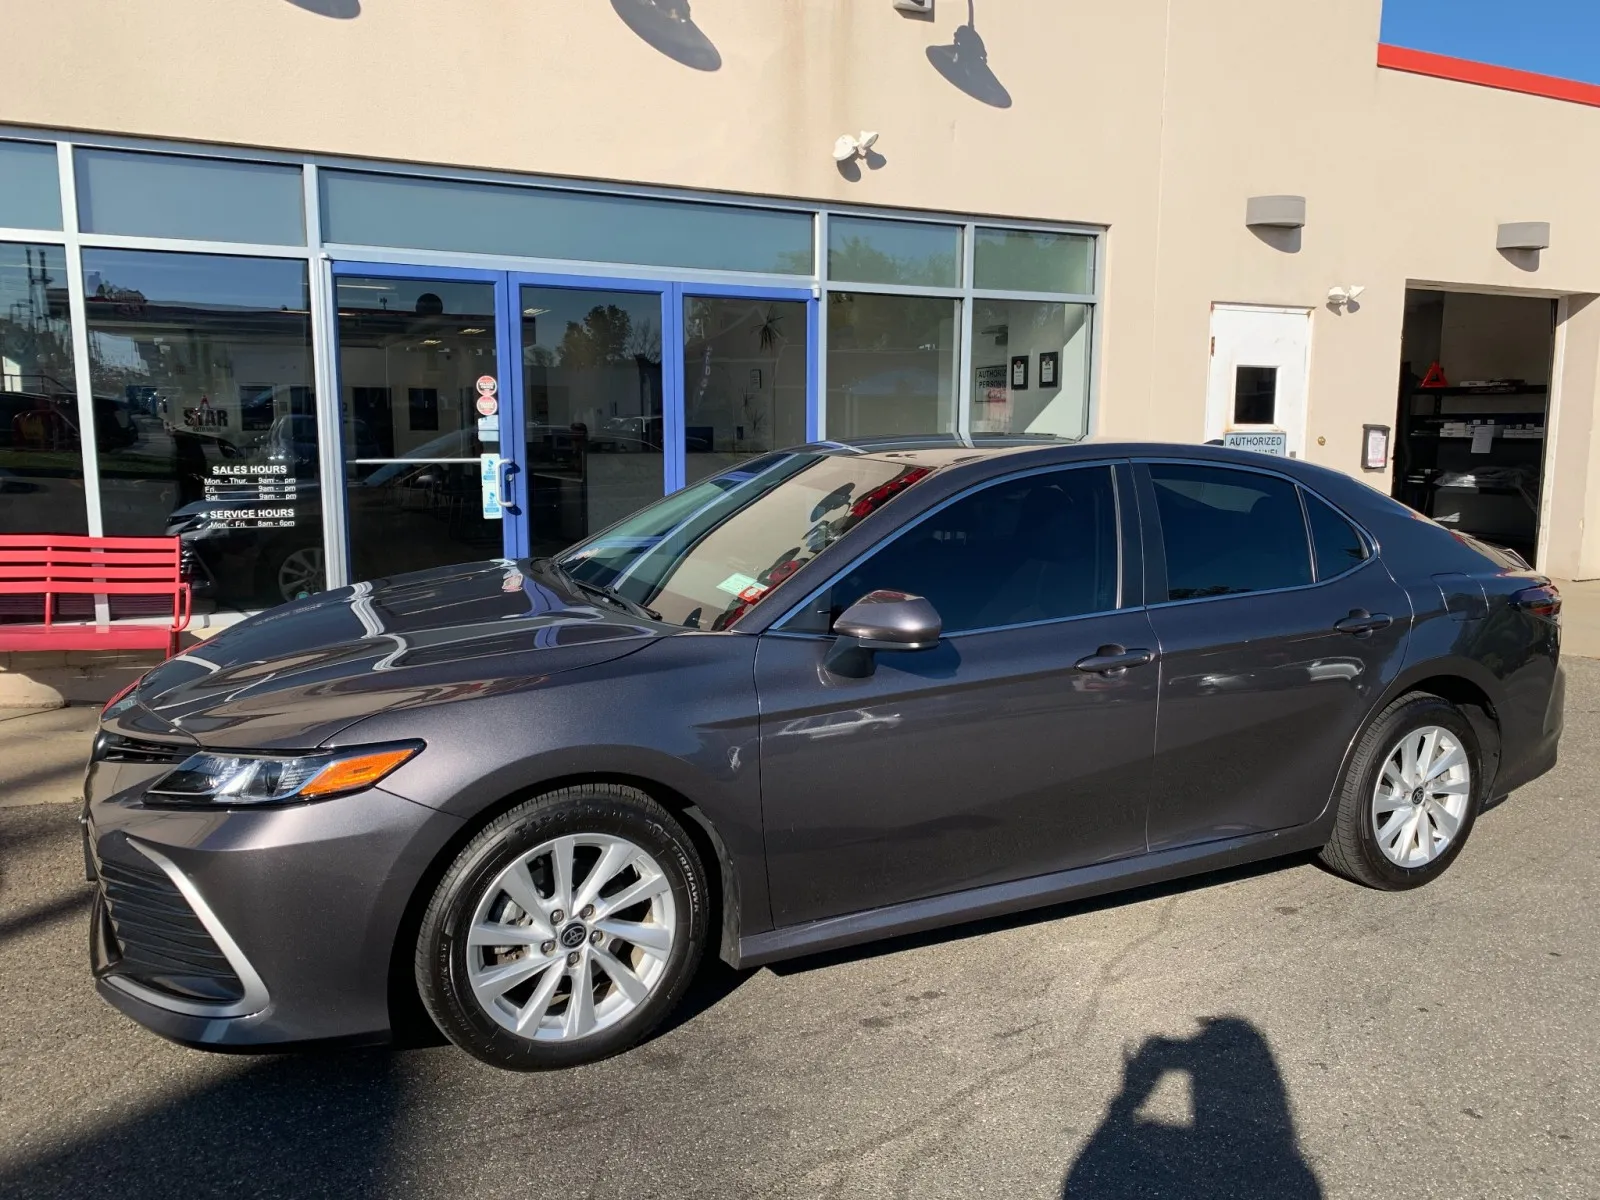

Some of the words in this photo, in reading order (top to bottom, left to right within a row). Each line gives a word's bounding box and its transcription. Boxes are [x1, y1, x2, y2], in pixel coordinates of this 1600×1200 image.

[1229, 436, 1282, 446] AUTHORIZED
[212, 465, 248, 475] SALES
[250, 465, 287, 474] HOURS
[229, 477, 248, 485] Thur.
[210, 510, 255, 519] SERVICE
[258, 508, 295, 518] HOURS
[671, 844, 701, 913] FIREHAWK
